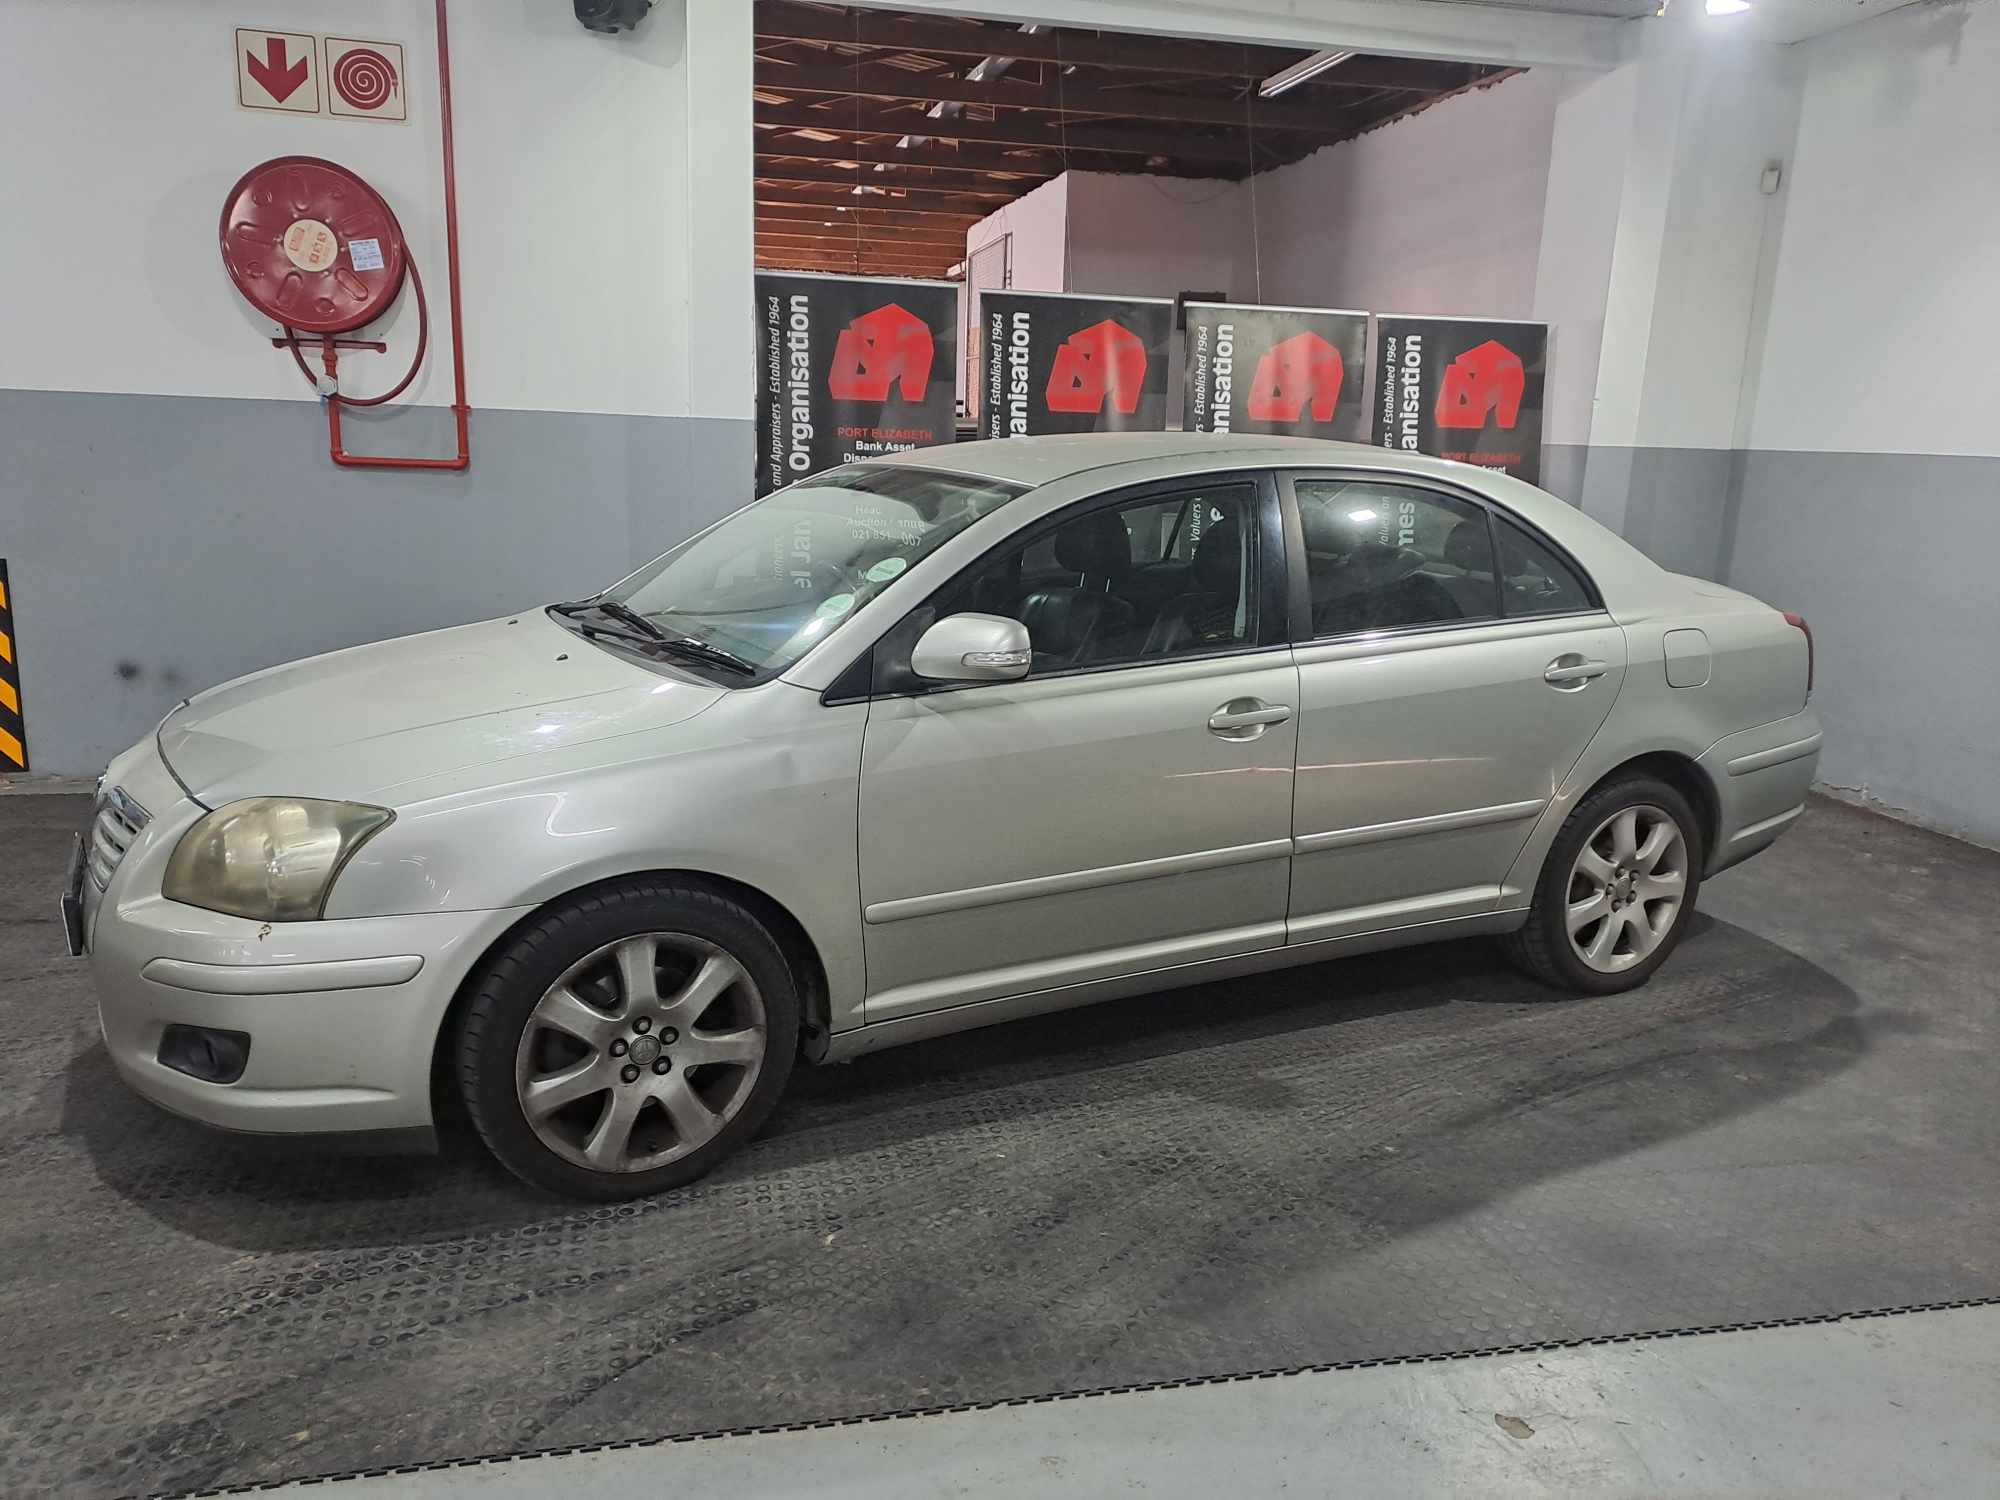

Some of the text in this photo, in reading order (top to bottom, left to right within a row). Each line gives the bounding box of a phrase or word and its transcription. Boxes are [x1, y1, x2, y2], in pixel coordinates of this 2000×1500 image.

[768, 296, 781, 325] 1964
[992, 313, 1003, 340] 1964
[1198, 326, 1208, 350] 1964
[1387, 337, 1397, 362] 1964
[768, 327, 781, 393] Established
[990, 342, 1002, 405] Established
[786, 295, 814, 471] Organisation
[1194, 354, 1207, 415] Established
[1383, 365, 1396, 424] Established
[1400, 335, 1421, 454] anisation
[769, 402, 784, 462] Appraisers
[837, 427, 869, 439] PORT
[855, 440, 884, 451] Bank
[770, 463, 782, 486] and
[1190, 503, 1201, 541] Valuers
